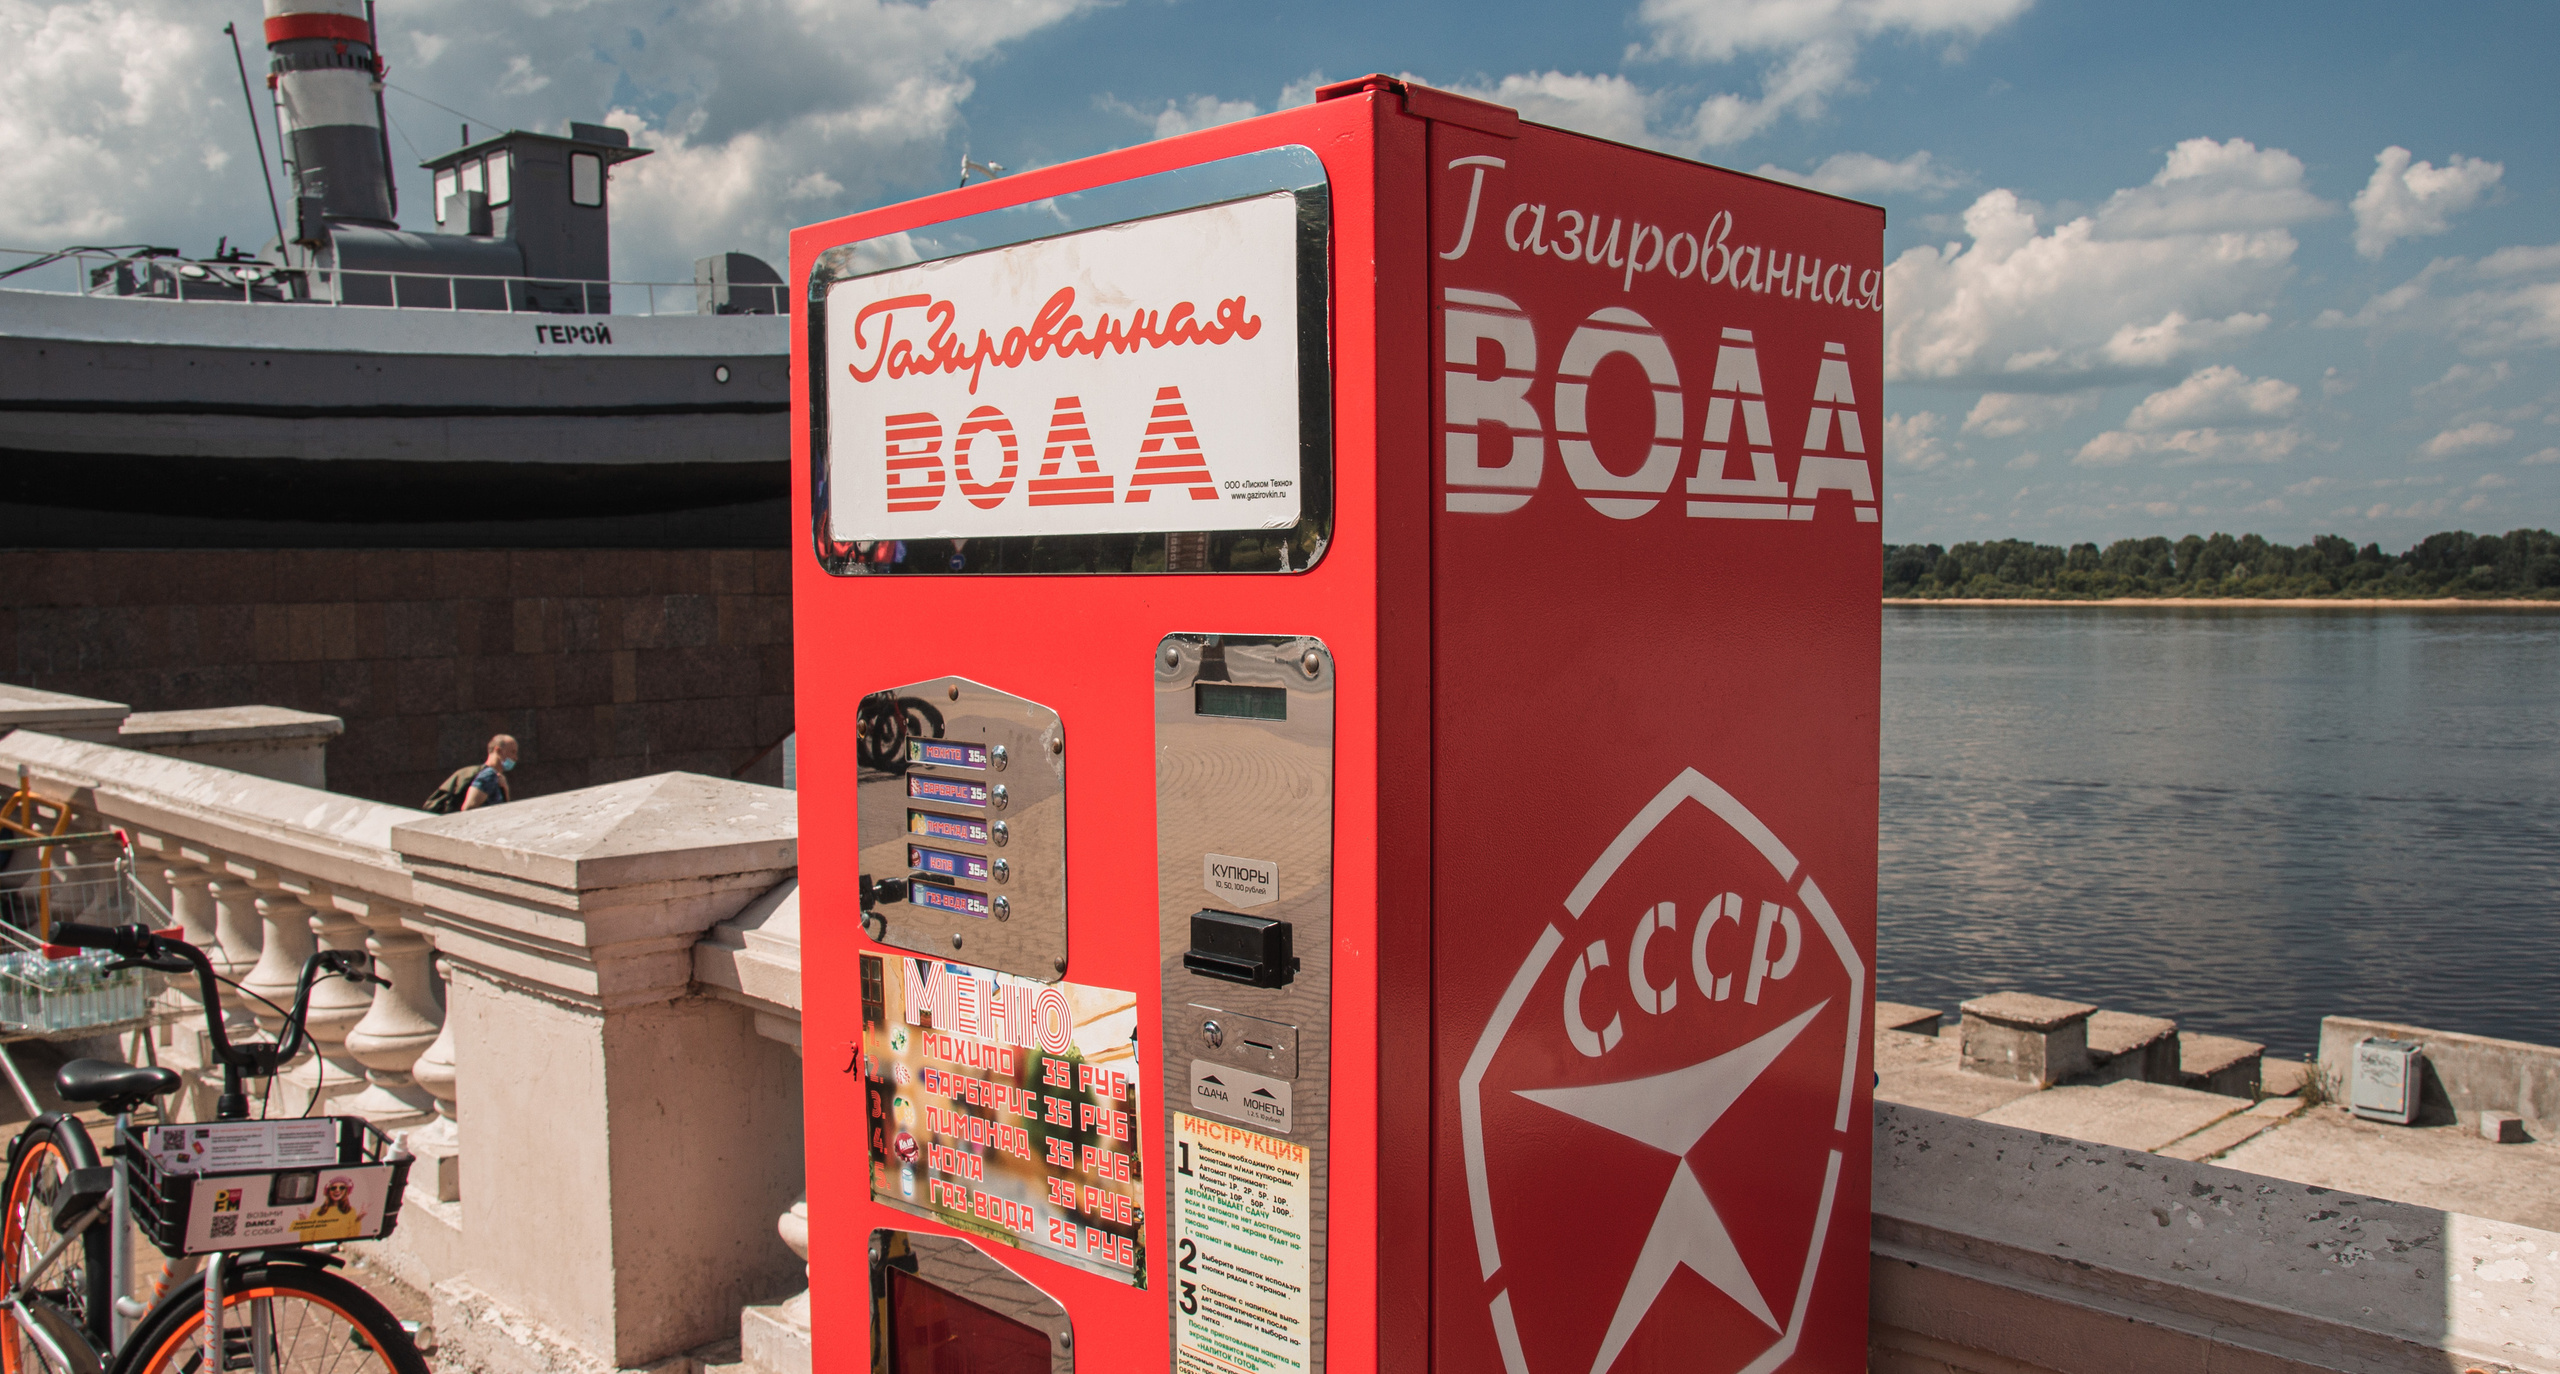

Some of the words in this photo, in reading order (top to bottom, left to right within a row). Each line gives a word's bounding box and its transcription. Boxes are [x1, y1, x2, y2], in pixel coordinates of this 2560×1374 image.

[1439, 155, 1883, 312] Газированная
[535, 322, 612, 344] ГЕРОЙ
[849, 286, 1262, 395] Газированная
[1444, 287, 1879, 522] ВОДА
[885, 386, 1220, 513] ВОДА
[1224, 480, 1240, 489] ООО
[1270, 479, 1293, 487] Техно»
[1231, 490, 1286, 501] www.gazirovkin.ru
[926, 746, 961, 760] МОХИТО
[923, 782, 968, 798] БАРБАРИС
[927, 820, 967, 839] ЛИМОНАД
[930, 857, 953, 872] КОЛА
[1212, 863, 1269, 885] КУПЮРЫ
[926, 892, 967, 910] ГАЗ-ВОДА
[1224, 882, 1234, 890] 50,
[1235, 884, 1245, 892] 100
[1245, 886, 1267, 895] рублей
[1563, 891, 1801, 1058] СССР
[904, 957, 1073, 1056] МЕНЮ
[868, 1020, 880, 1047] 1.
[922, 1031, 1014, 1077] МОХИТО
[1042, 1057, 1071, 1089] 35
[1079, 1064, 1127, 1101] РУБ
[868, 1054, 884, 1084] 2.
[925, 1068, 1038, 1120] БАРБАРИС
[1044, 1096, 1073, 1128] 35
[1080, 1103, 1129, 1142] РУБ
[1197, 1086, 1229, 1102] СДАЧА
[1243, 1097, 1285, 1117] МОНЕТЫ
[871, 1090, 886, 1120] 3.
[926, 1106, 1031, 1161] ЛИМОНАД
[1046, 1136, 1074, 1169] 35
[1082, 1145, 1130, 1184] РУБ
[1184, 1115, 1303, 1164] ИНСТРУКЦИЯ
[1178, 1141, 1193, 1177] 1
[1199, 1155, 1233, 1169] монетами
[1234, 1165, 1254, 1176] и/или
[1256, 1171, 1294, 1187] купюрами.
[1228, 1153, 1276, 1171] необходимую
[1277, 1167, 1300, 1180] сумму
[928, 1143, 984, 1182] КОЛА
[1048, 1176, 1077, 1210] 35
[1084, 1185, 1132, 1226] РУБ
[1199, 1164, 1227, 1178] Автомат
[1229, 1173, 1268, 1190] принимает:
[1199, 1173, 1227, 1187] Монеты-
[1200, 1183, 1228, 1198] Купюры-
[247, 1211, 283, 1219] ВОЗЬМИ
[1185, 1187, 1215, 1202] АВТОМАТ
[1217, 1196, 1244, 1212] ВЫДАЕТ
[1245, 1206, 1270, 1220] СДАЧУ
[245, 1219, 276, 1228] DANCE
[252, 1227, 283, 1236] СОБОЙ
[929, 1178, 1035, 1234] ГАЗ-ВОДА
[1048, 1216, 1078, 1250] 25
[1086, 1226, 1134, 1268] РУБ
[1185, 1198, 1201, 1208] если
[1208, 1206, 1239, 1220] автомате
[1241, 1216, 1252, 1225] нет
[1254, 1221, 1301, 1240] достаточного
[1185, 1217, 1209, 1231] писано
[1185, 1208, 1206, 1220] кол-ва
[1231, 1223, 1240, 1231] на
[1242, 1227, 1267, 1240] экране
[1269, 1234, 1288, 1247] будет
[1290, 1242, 1302, 1250] на-
[1179, 1238, 1197, 1275] 2
[1195, 1231, 1222, 1246] автомат
[1224, 1240, 1232, 1249] не
[1234, 1244, 1258, 1257] выдает
[1202, 1252, 1234, 1270] Выберите
[1236, 1266, 1264, 1280] напиток
[1265, 1276, 1301, 1294] используя
[1202, 1264, 1225, 1277] кнопки
[1227, 1273, 1248, 1285] рядом
[1179, 1279, 1198, 1316] 3
[1201, 1284, 1237, 1303] Стаканчик
[1245, 1301, 1278, 1317] напитком
[1280, 1313, 1300, 1325] выпа-
[204, 1288, 215, 1350] LUCKY
[1201, 1296, 1212, 1304] дет
[1214, 1300, 1265, 1323] автоматически
[1267, 1319, 1288, 1331] после
[1202, 1305, 1233, 1321] внесения
[1234, 1318, 1253, 1329] денег
[1261, 1327, 1288, 1341] выбора
[1179, 1348, 1214, 1367] Уважаемые
[1189, 1331, 1213, 1344] экране
[1214, 1340, 1244, 1356] появится
[1189, 1319, 1209, 1333] После
[1211, 1329, 1260, 1352] приготовления
[1261, 1348, 1290, 1364] напитка
[1291, 1360, 1301, 1369] на
[1197, 1343, 1232, 1362] «НАПИТОК
[1234, 1356, 1260, 1372] ГОТОВ»
